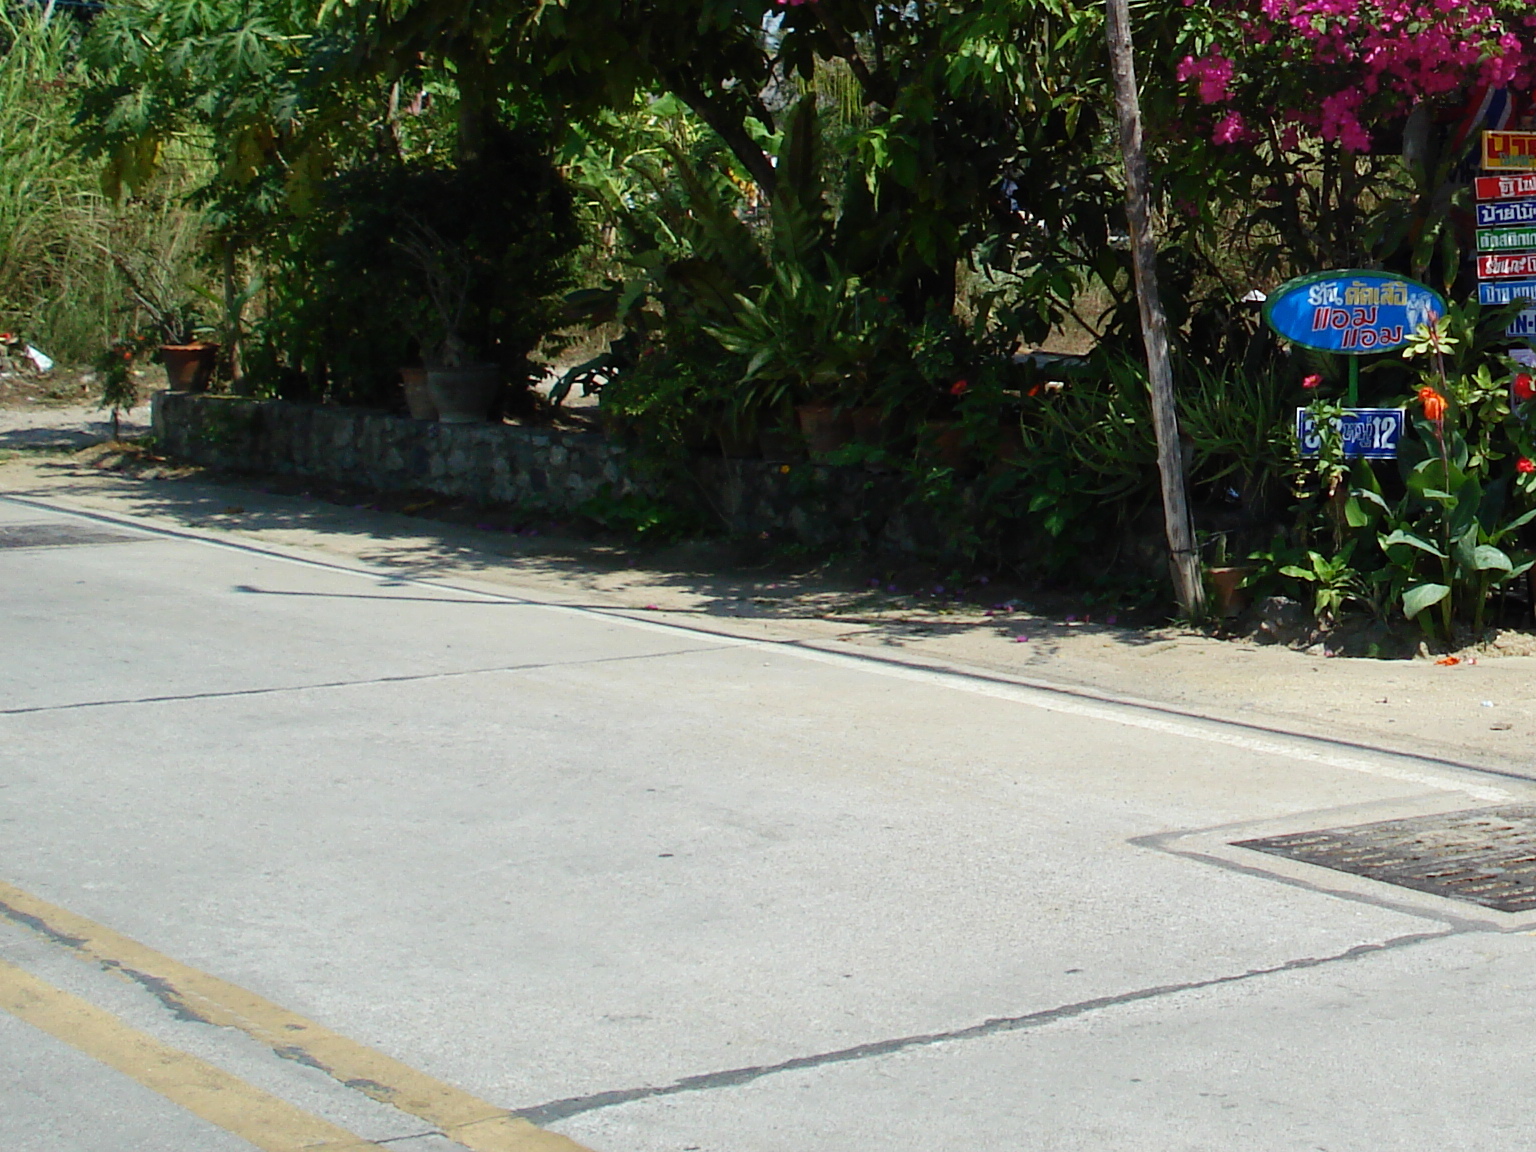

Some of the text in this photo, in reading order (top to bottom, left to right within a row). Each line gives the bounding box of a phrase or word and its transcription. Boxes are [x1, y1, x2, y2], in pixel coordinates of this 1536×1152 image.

[1312, 306, 1378, 331] แอม
[1341, 325, 1403, 348] แอม
[1373, 416, 1397, 449] 12
